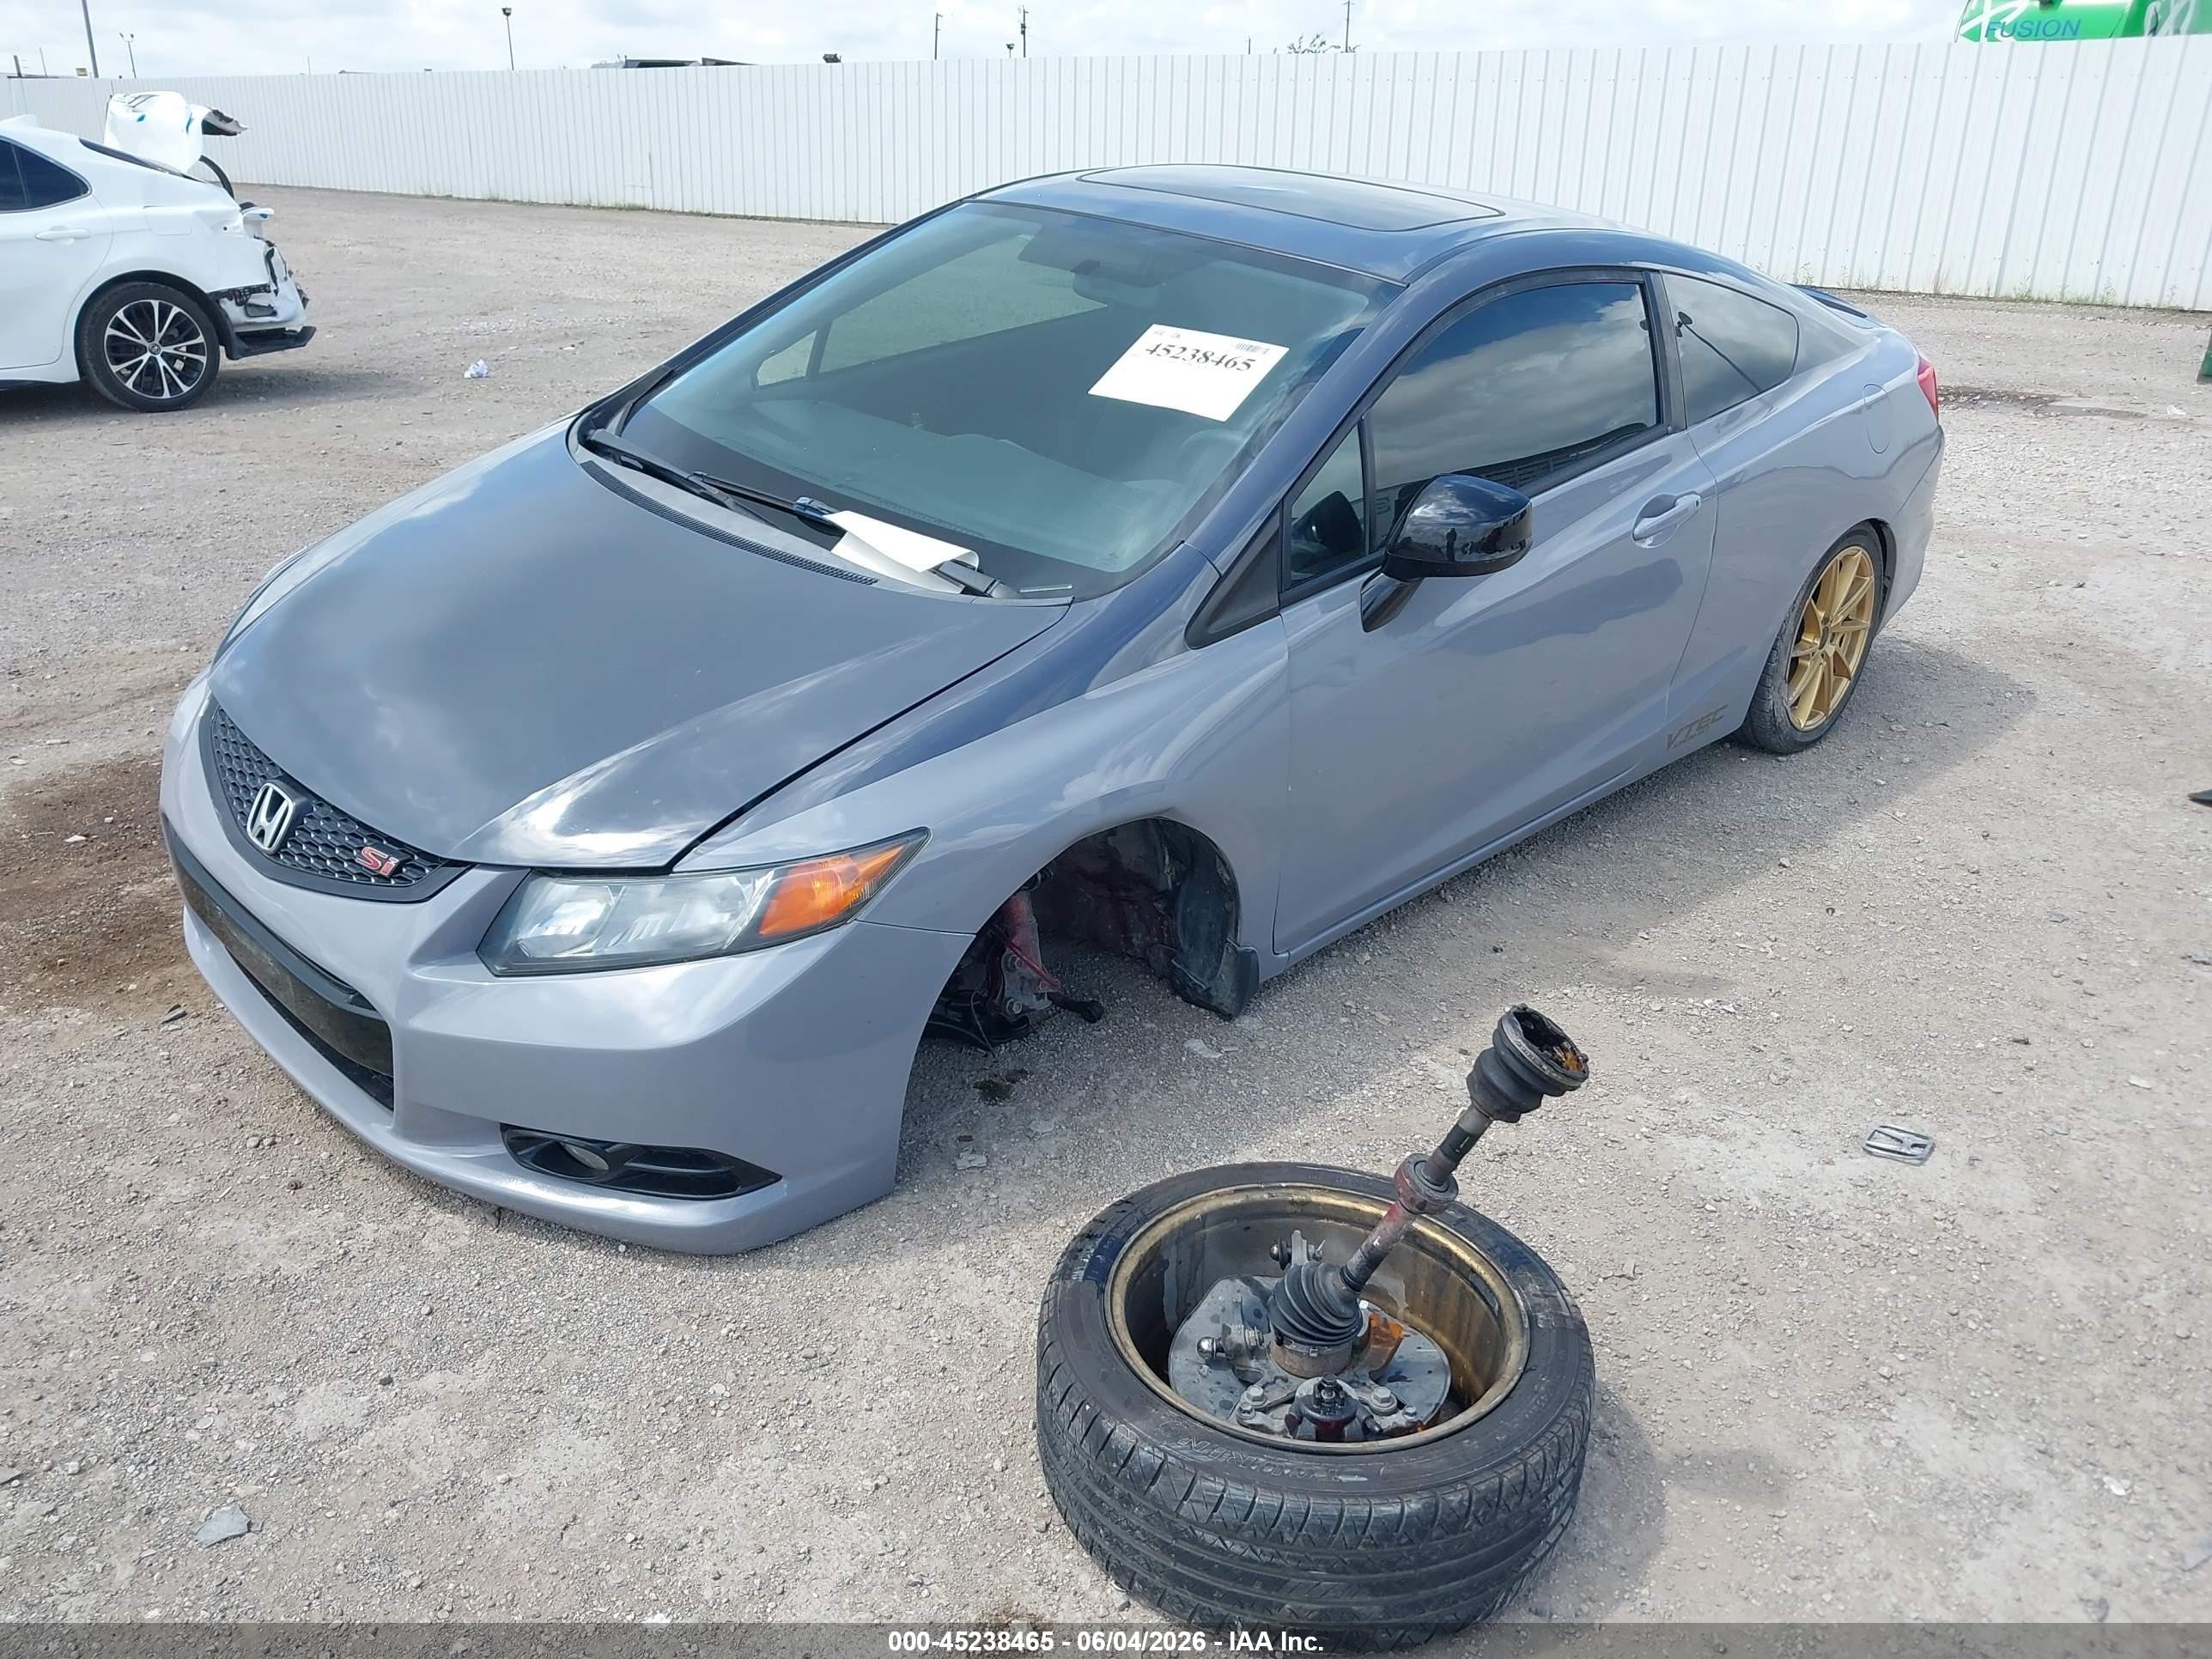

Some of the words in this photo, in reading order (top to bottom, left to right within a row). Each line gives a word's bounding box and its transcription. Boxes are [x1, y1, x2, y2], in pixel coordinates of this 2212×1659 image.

[1984, 19, 2081, 38] FUSION
[1146, 343, 1255, 371] 45238465
[1667, 704, 1729, 750] VTEC
